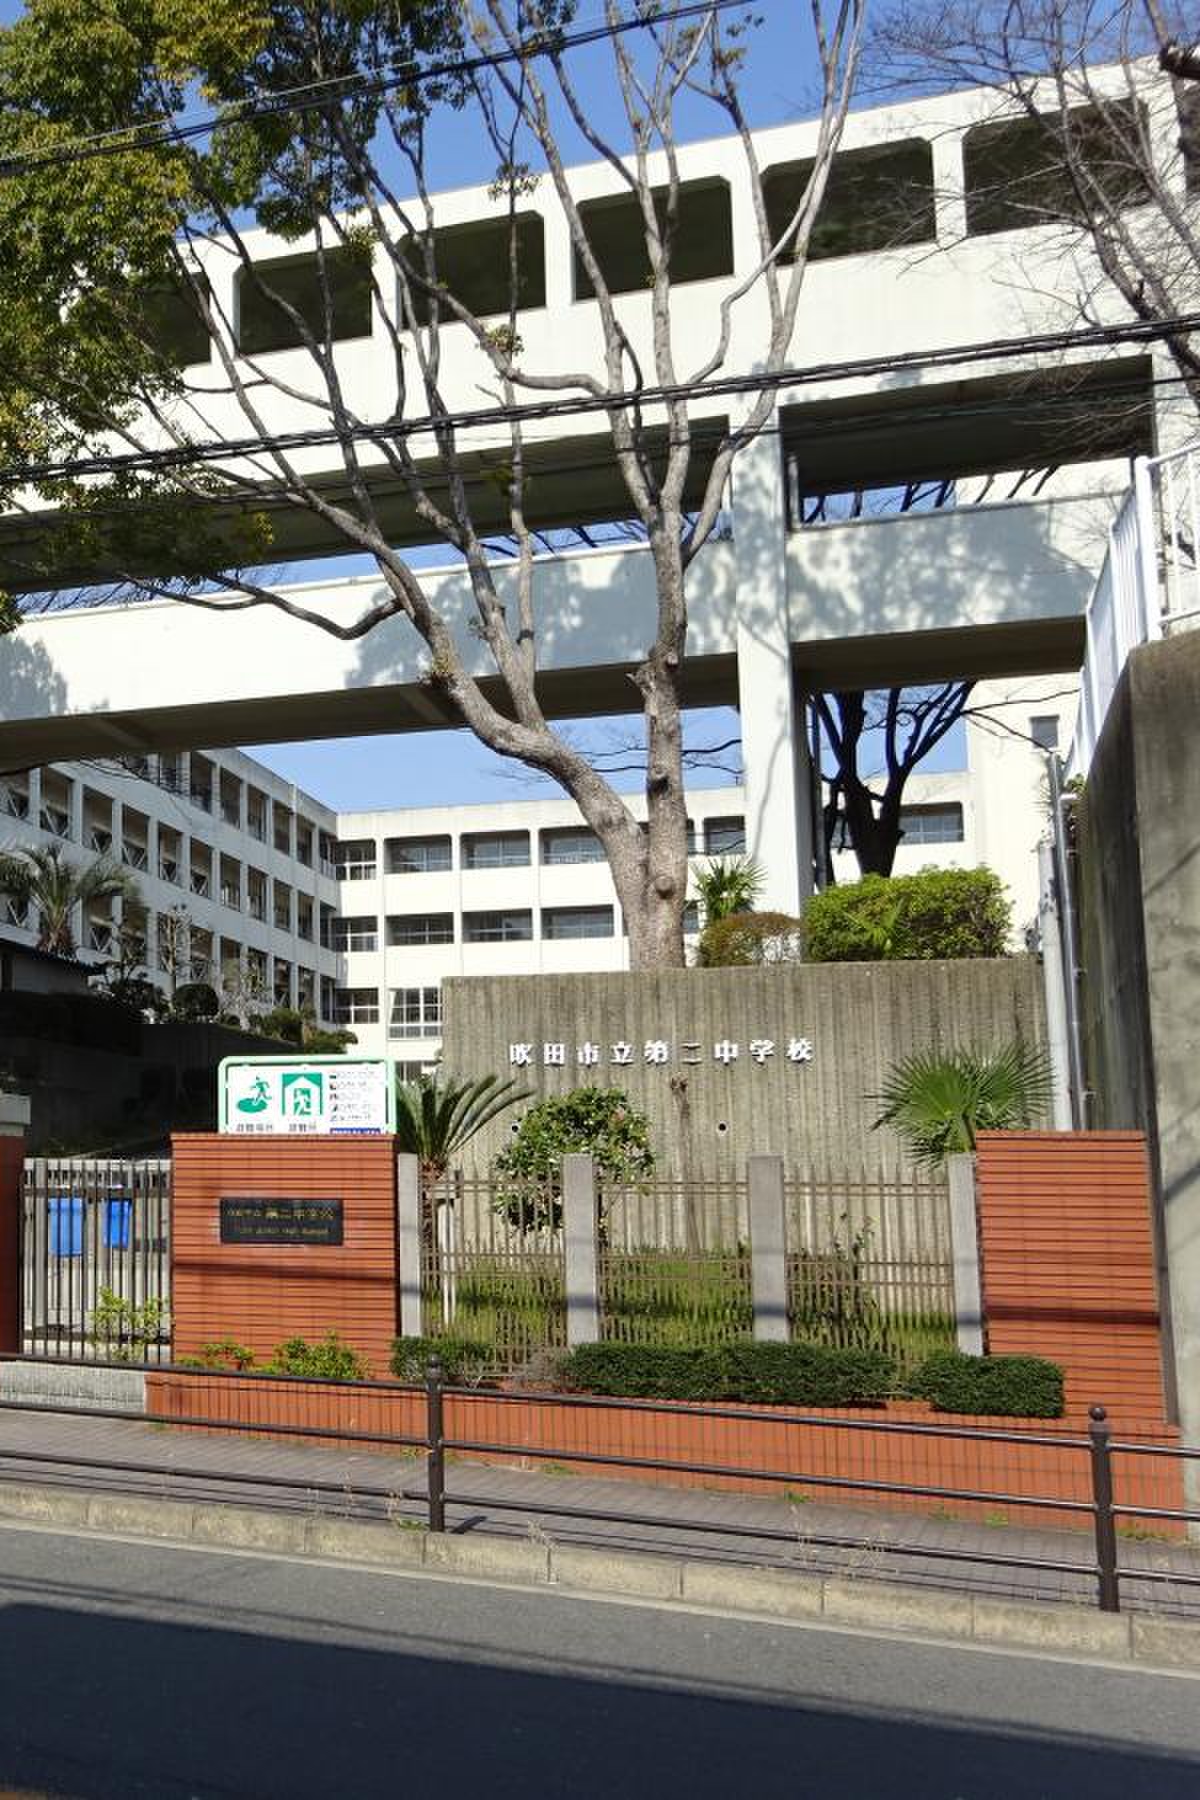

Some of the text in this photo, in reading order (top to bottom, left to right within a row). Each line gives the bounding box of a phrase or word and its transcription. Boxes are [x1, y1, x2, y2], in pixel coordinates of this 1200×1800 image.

[509, 1037, 815, 1065] 吹田市立第二中学校
